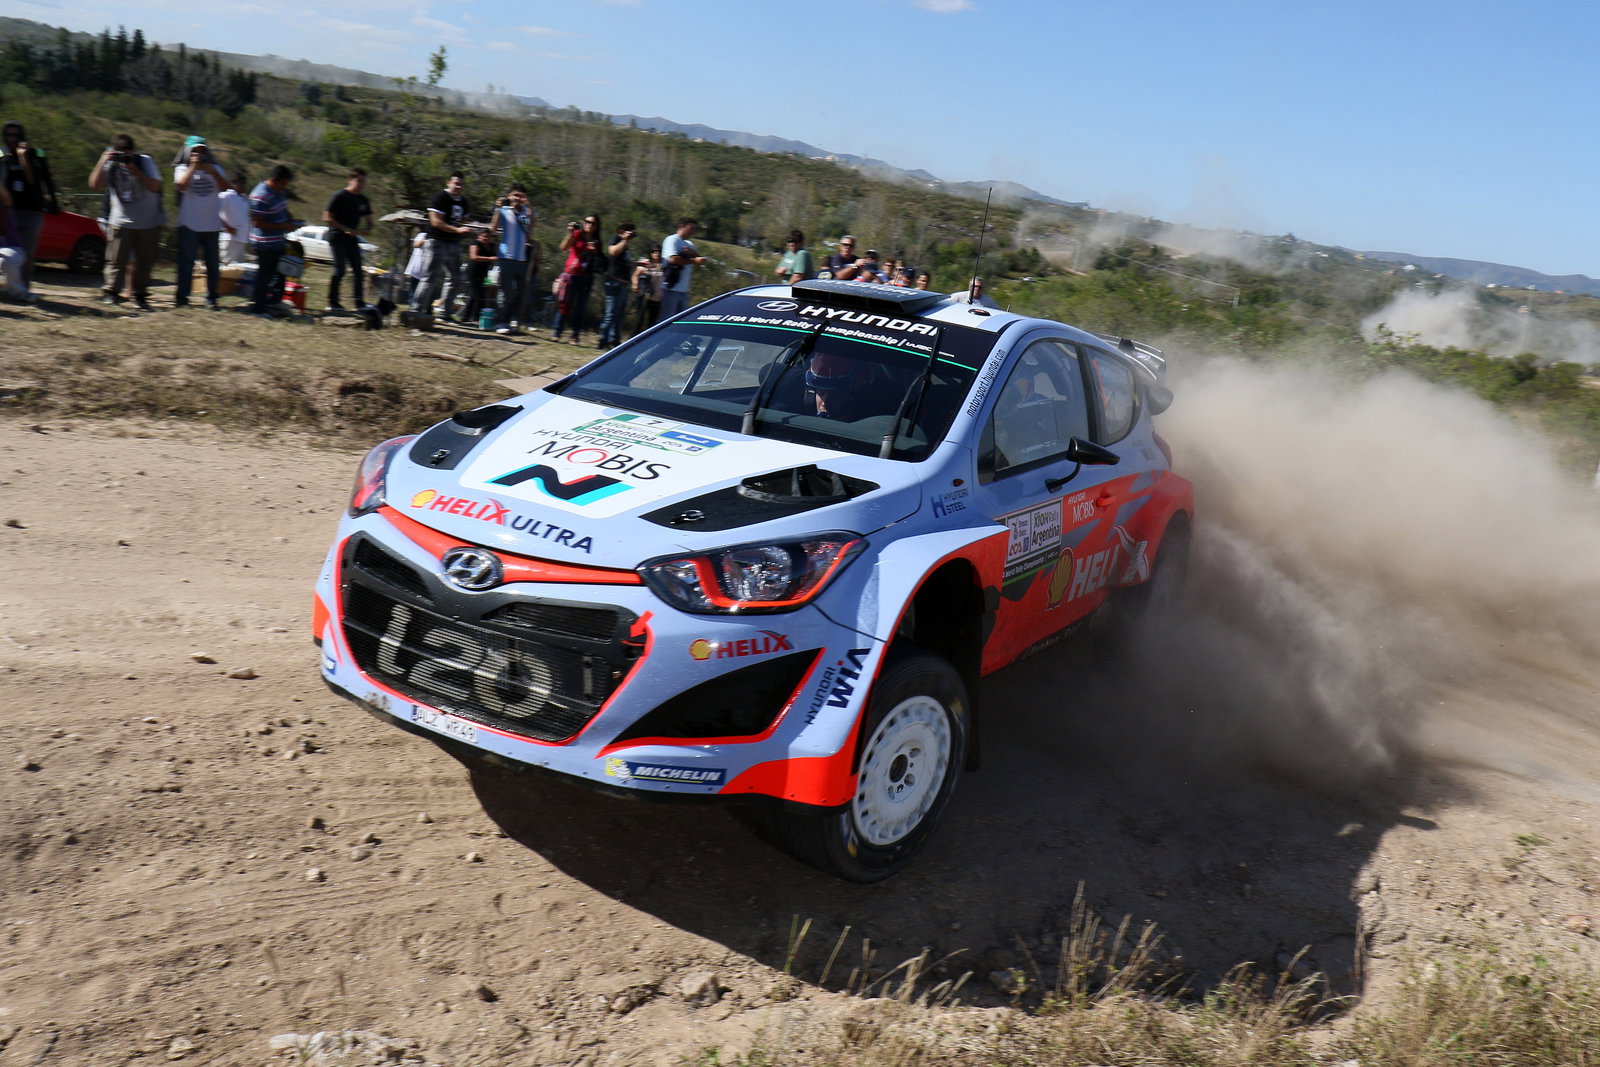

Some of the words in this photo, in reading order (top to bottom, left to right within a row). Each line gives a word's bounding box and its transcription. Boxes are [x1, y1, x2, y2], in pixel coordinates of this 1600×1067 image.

[748, 316, 781, 326] World
[782, 320, 814, 330] Rally
[799, 305, 939, 337] HYUNDAI
[966, 348, 1006, 418] motorsport.hyundai.com
[532, 428, 633, 452] HYUNDAI
[588, 425, 657, 442] Argentina
[527, 440, 672, 481] MOBIS
[944, 488, 969, 501] HYUNDAI
[946, 501, 967, 514] STEEL
[1072, 499, 1096, 524] MOBIS
[429, 494, 512, 527] HELIX
[511, 515, 595, 554] ULTRA
[1031, 524, 1060, 546] Argentina
[1066, 525, 1150, 603] HELIX
[716, 630, 795, 660] HELIX
[804, 666, 837, 726] HYUNDAI
[633, 765, 722, 783] MICHELIN
